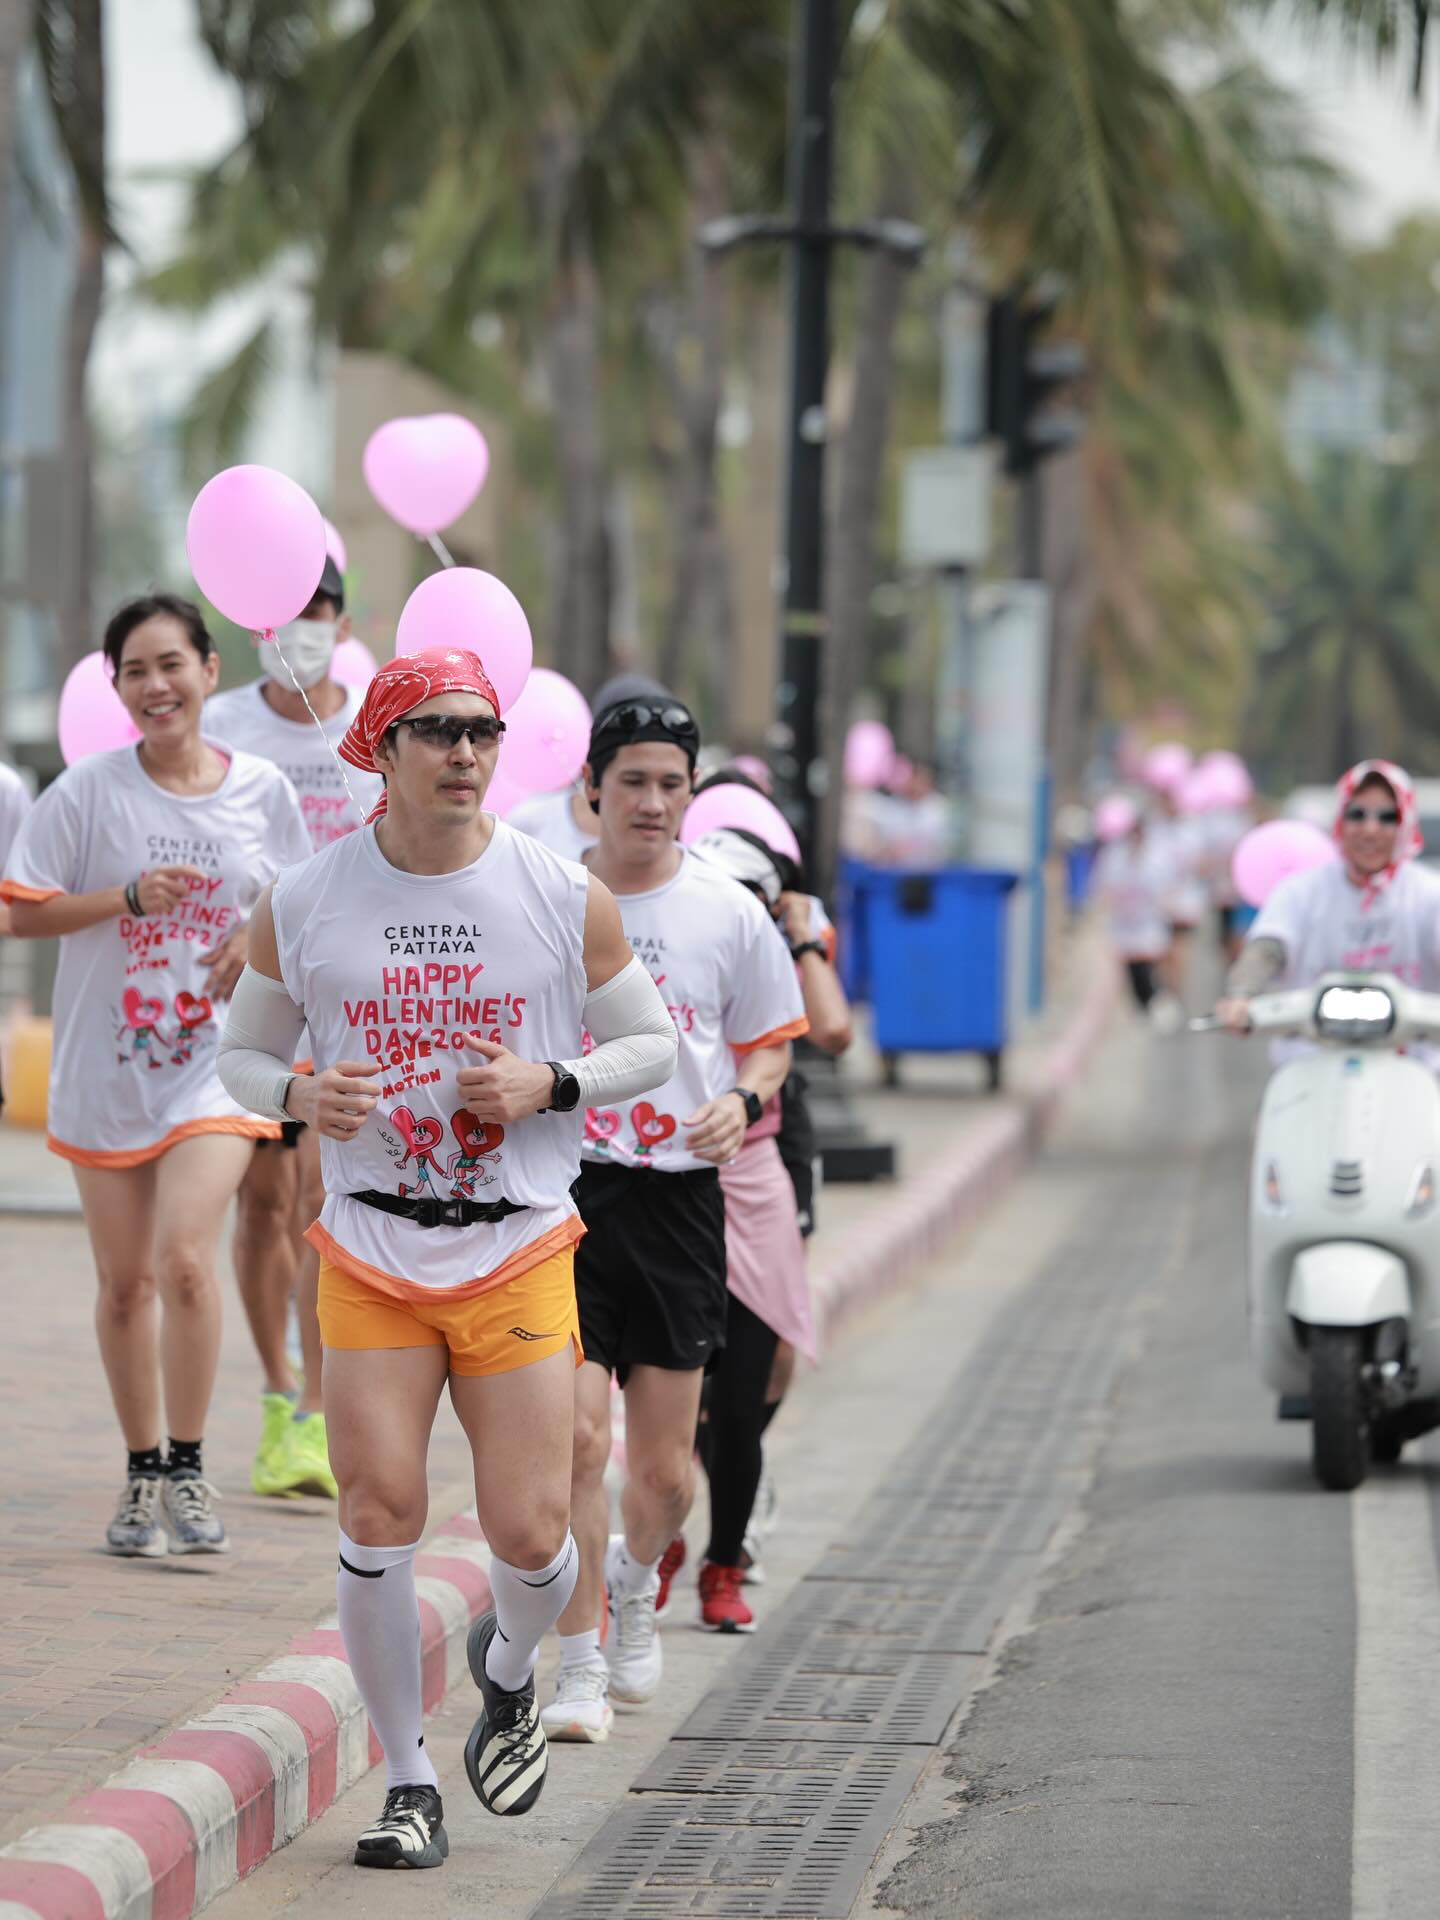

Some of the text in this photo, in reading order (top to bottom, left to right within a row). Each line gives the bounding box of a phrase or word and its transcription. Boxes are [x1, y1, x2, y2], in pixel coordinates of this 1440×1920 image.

[147, 835, 224, 856] CENTRAL
[150, 850, 219, 868] PATTAYA
[384, 924, 482, 940] CENTRAL
[390, 940, 475, 956] PATTAYA
[382, 962, 484, 995] HAPPY
[343, 992, 526, 1027] VALENTINE'S
[365, 1027, 423, 1055] DAY
[376, 1040, 432, 1073] LOVE
[400, 1062, 415, 1075] IN
[382, 1068, 441, 1099] MOTION
